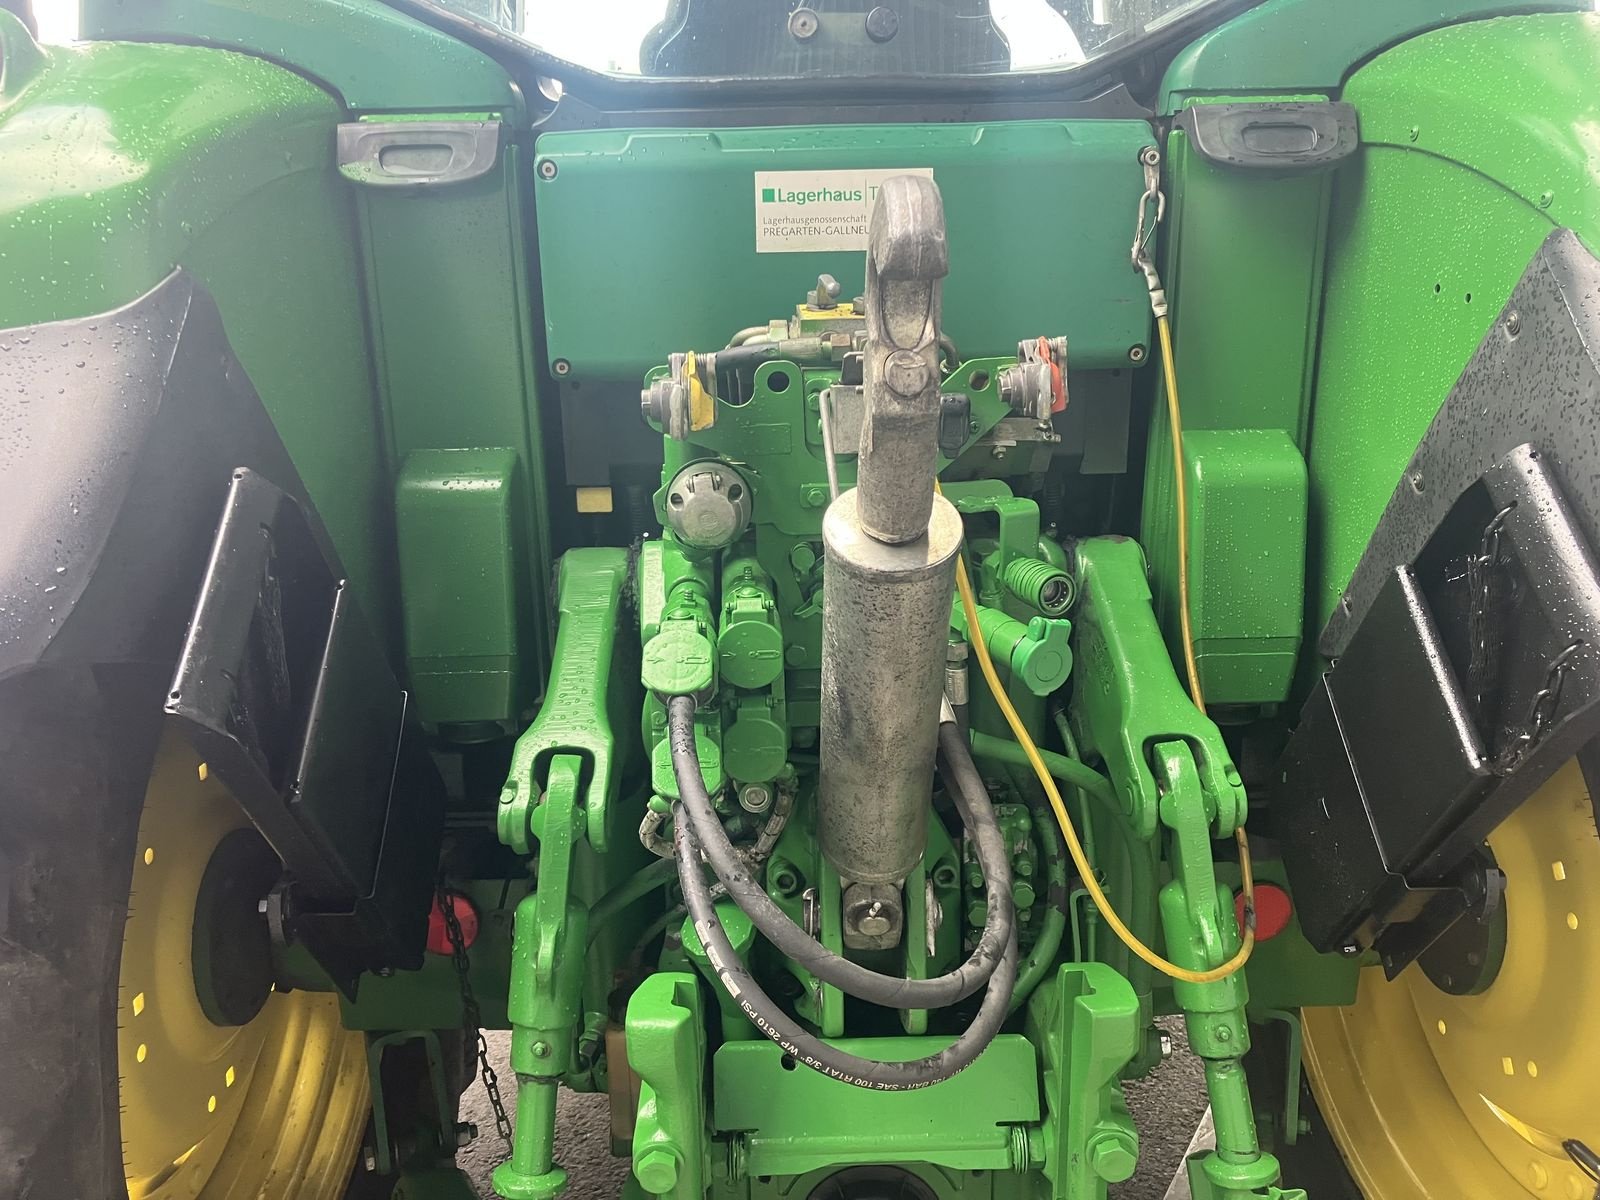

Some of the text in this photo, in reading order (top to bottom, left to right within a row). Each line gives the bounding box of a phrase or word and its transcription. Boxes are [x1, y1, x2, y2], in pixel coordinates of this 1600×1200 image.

[778, 187, 862, 205] Lagerhaus
[763, 214, 867, 226] Lagerhausgenossenschaft
[740, 999, 758, 1019] PSI
[757, 1017, 781, 1041] 2610
[780, 1041, 799, 1057] WP
[822, 1066, 854, 1083] R1AT
[854, 1078, 874, 1089] 100
[877, 1082, 899, 1091] SAE
